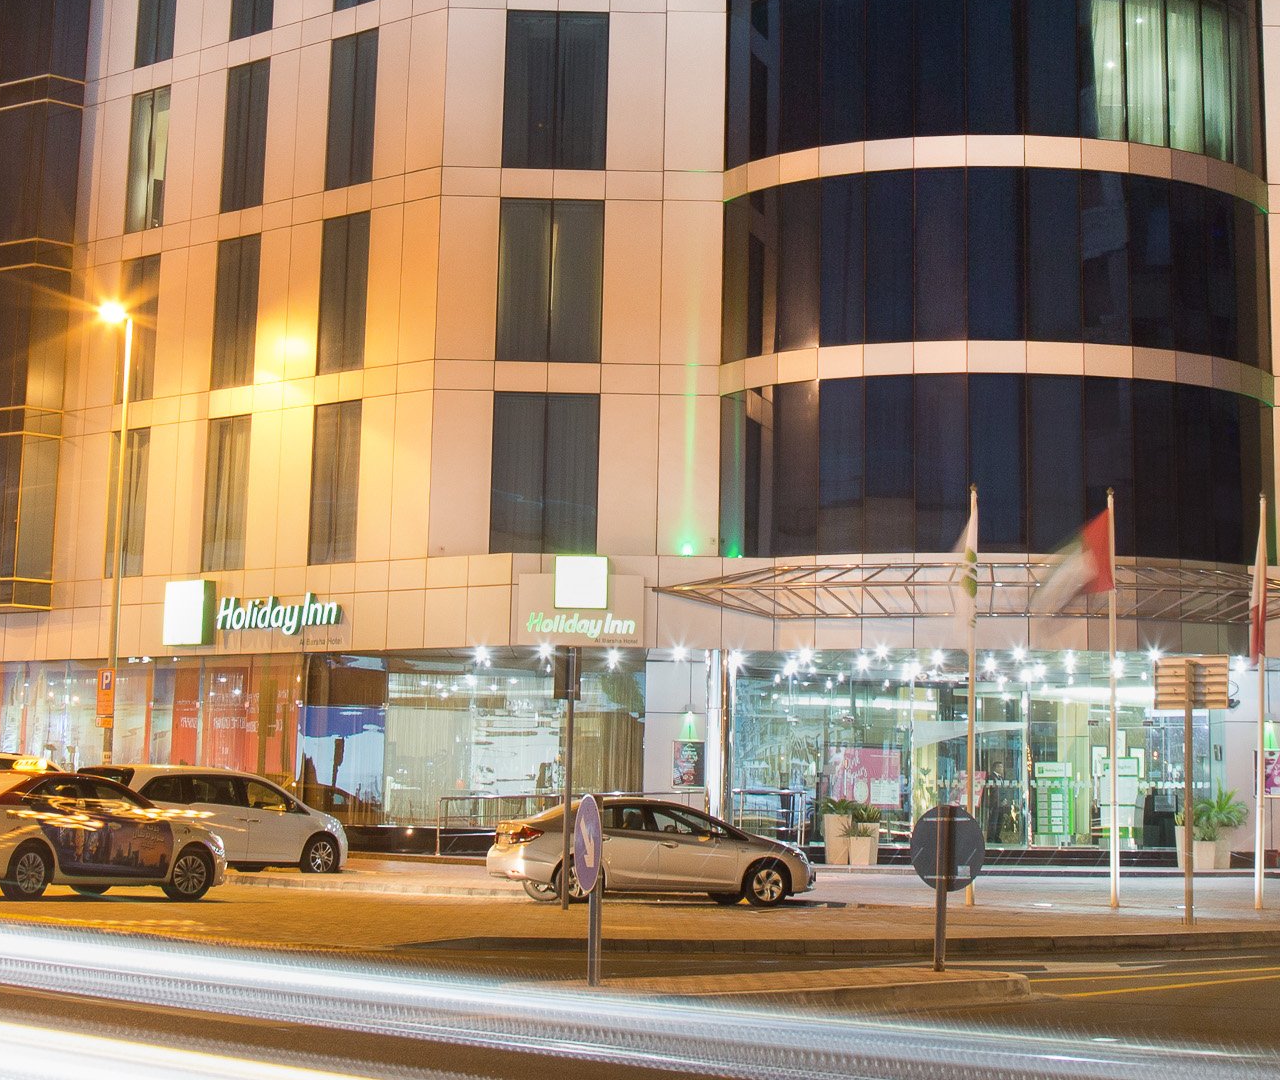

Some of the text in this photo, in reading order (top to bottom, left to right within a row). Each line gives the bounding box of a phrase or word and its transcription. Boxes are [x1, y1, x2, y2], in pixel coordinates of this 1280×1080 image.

[216, 591, 341, 636] Holiday Inn
[526, 611, 636, 639] Holiday Inn
[102, 672, 111, 690] P
